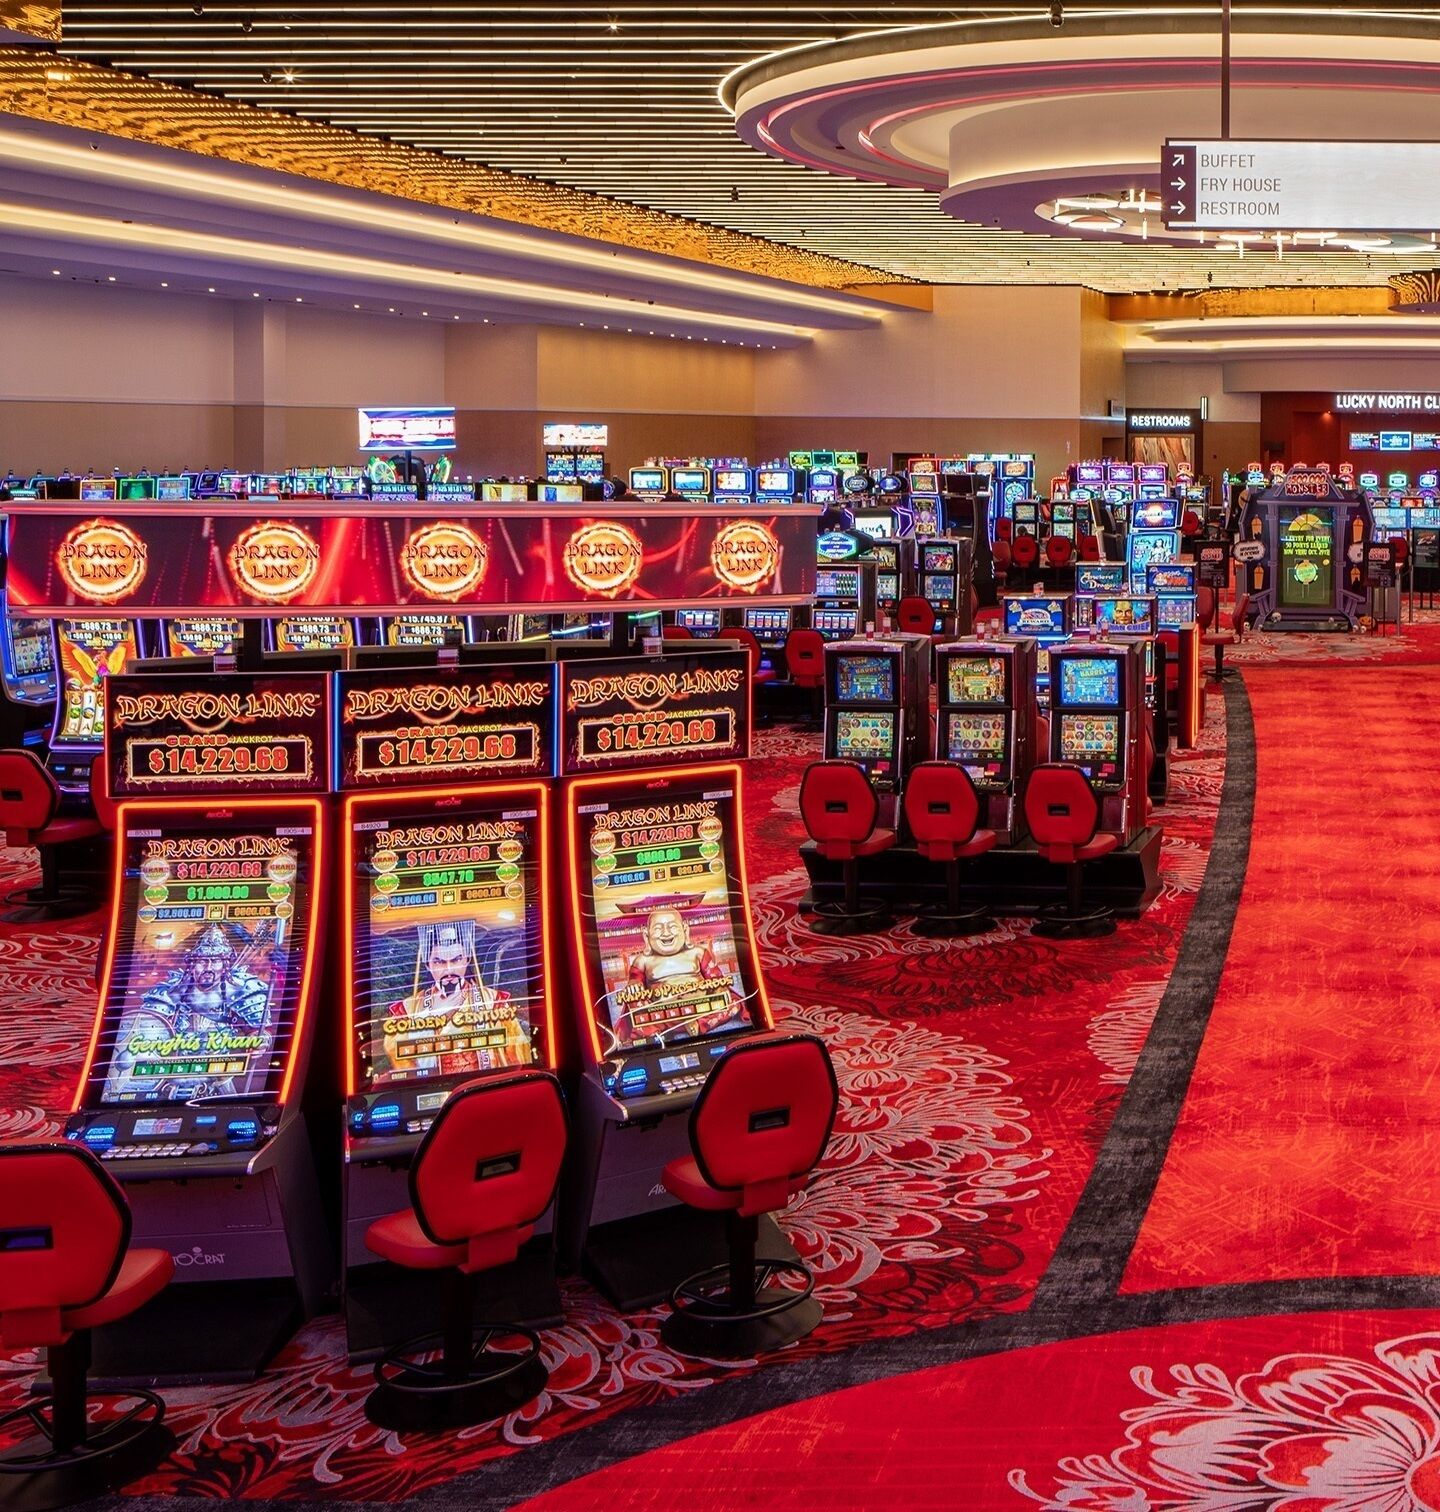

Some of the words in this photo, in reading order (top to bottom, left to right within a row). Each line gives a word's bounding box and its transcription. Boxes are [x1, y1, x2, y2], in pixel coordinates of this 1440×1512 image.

[1201, 154, 1255, 169] BUFFET
[1201, 178, 1228, 192] FRY
[1232, 178, 1281, 192] HOUSE
[1201, 201, 1280, 216] RESTROOM
[1336, 395, 1375, 409] LUCKY
[1378, 395, 1421, 409] NORTH
[1131, 415, 1191, 429] RESTROOMS
[62, 543, 147, 560] DRAGON
[233, 543, 319, 560] DRAGON
[405, 542, 488, 560] DRAGON
[566, 541, 642, 558] DRAGON
[712, 540, 779, 557] DRAGON
[79, 563, 127, 579] LINK
[251, 563, 300, 579] LINK
[421, 562, 468, 578] LINK
[581, 560, 626, 576] LINK
[725, 556, 763, 572] LINK
[571, 674, 678, 702] DRAGON
[681, 669, 739, 694] LINK
[117, 693, 240, 720] DRAGON
[245, 692, 316, 717] LINK
[348, 685, 470, 713] DRAGON
[477, 682, 544, 708] LINK
[612, 711, 666, 725] GRAND
[669, 709, 704, 720] JACKPOT
[396, 725, 459, 739] GRAND
[462, 724, 502, 734] JACKPOT
[598, 719, 716, 751] $14,229.68
[165, 735, 228, 747] GRAND
[232, 735, 273, 744] JACKPOT
[379, 734, 517, 766] $14,229.68
[149, 747, 289, 774] $14,229.68
[594, 807, 671, 829] DRAGON
[674, 801, 716, 821] LINK
[376, 825, 463, 849] DRAGON
[467, 822, 516, 841] LINK
[621, 825, 694, 848] $14,229.68
[147, 838, 235, 858] DRAGON
[239, 838, 289, 856] LINK
[406, 845, 490, 867] $14,229.68
[177, 861, 262, 880] $14,229.68
[617, 989, 653, 1004] HAPPY
[662, 976, 734, 998] PROSPEROUS
[383, 1015, 447, 1034] GOLDEN
[451, 1006, 516, 1027] CENTURY
[128, 1035, 200, 1056] Genghis
[206, 1030, 264, 1050] Khan
[172, 1253, 225, 1266] TOCRAT
